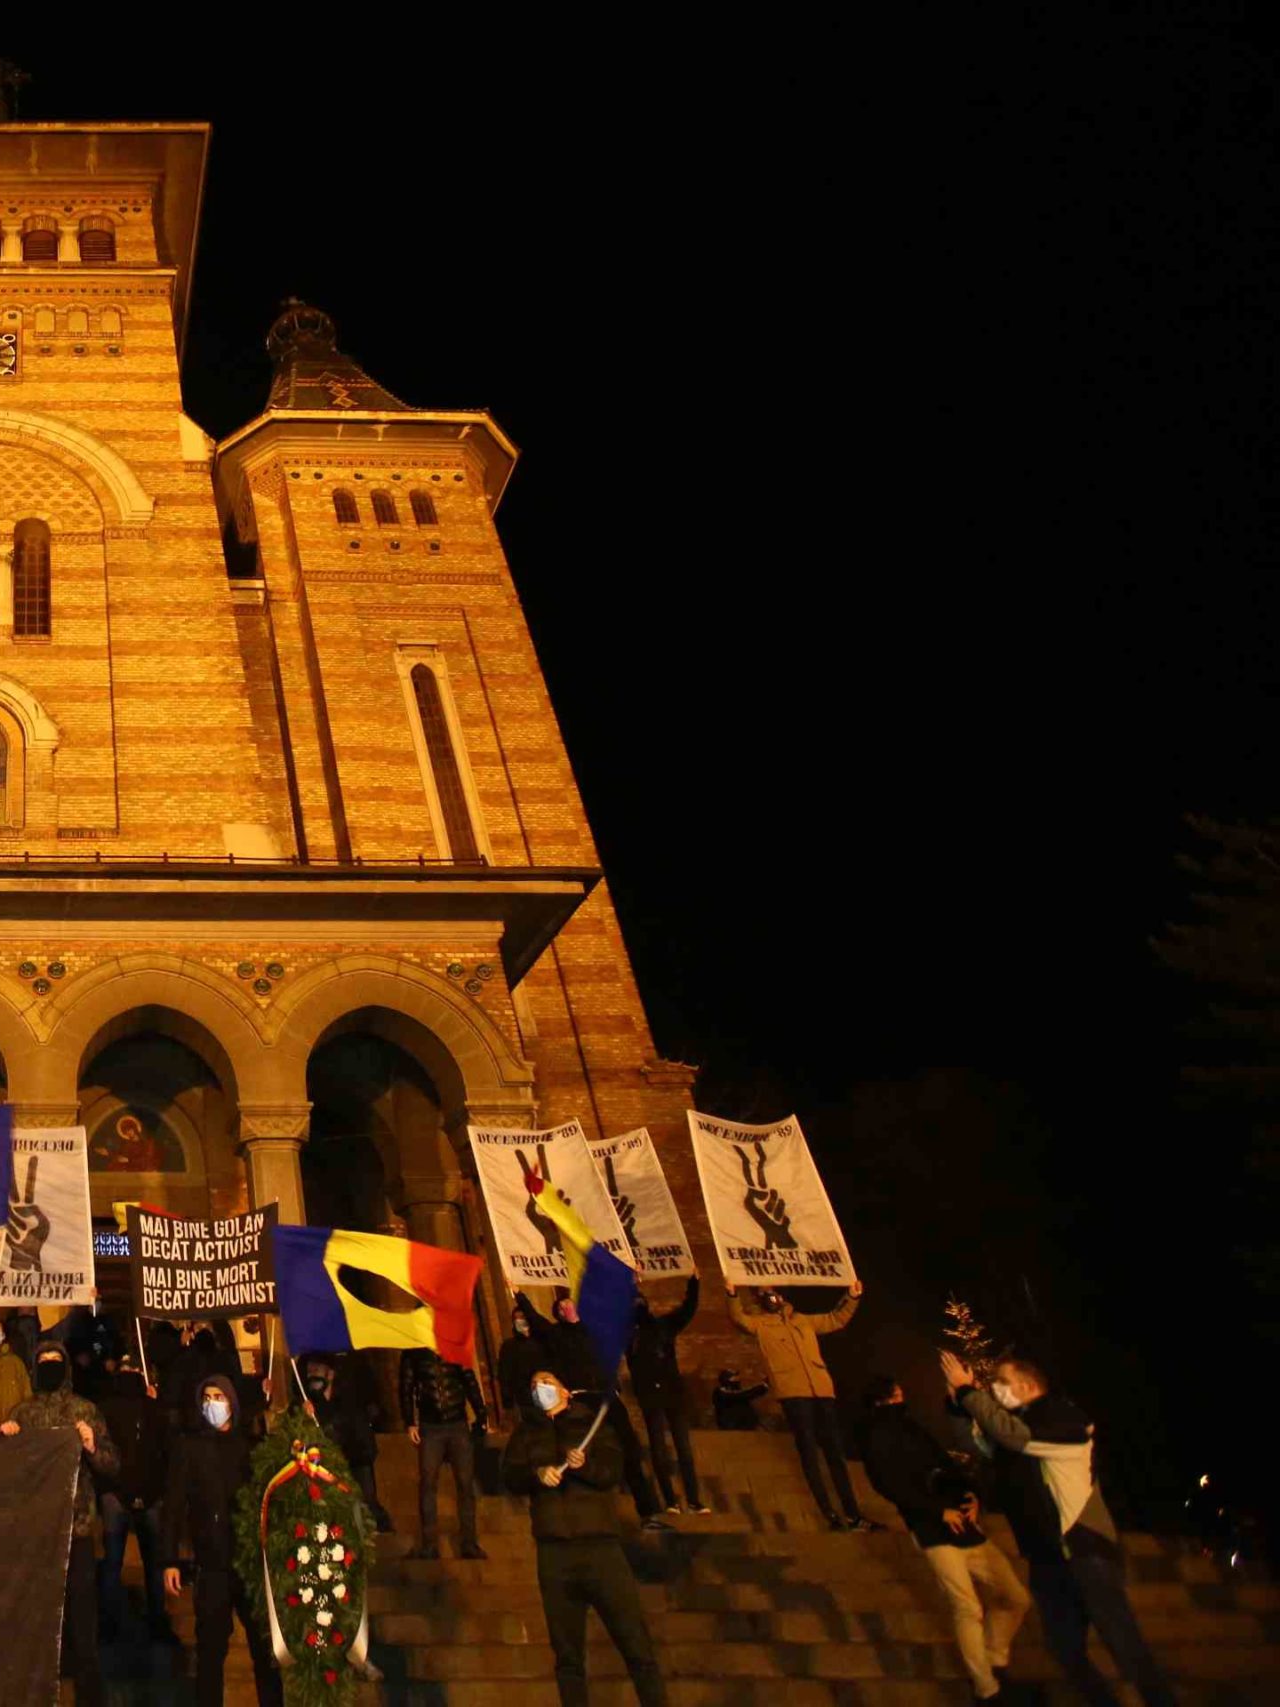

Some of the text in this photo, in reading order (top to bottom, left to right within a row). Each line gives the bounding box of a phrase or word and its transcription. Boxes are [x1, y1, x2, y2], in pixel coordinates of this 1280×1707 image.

[139, 1213, 264, 1239] MAI BINE GOLAN
[194, 1232, 261, 1262] ACTIVIST
[142, 1261, 259, 1290] MAI BINE MORT
[143, 1281, 276, 1310] DECAT COMUNIST
